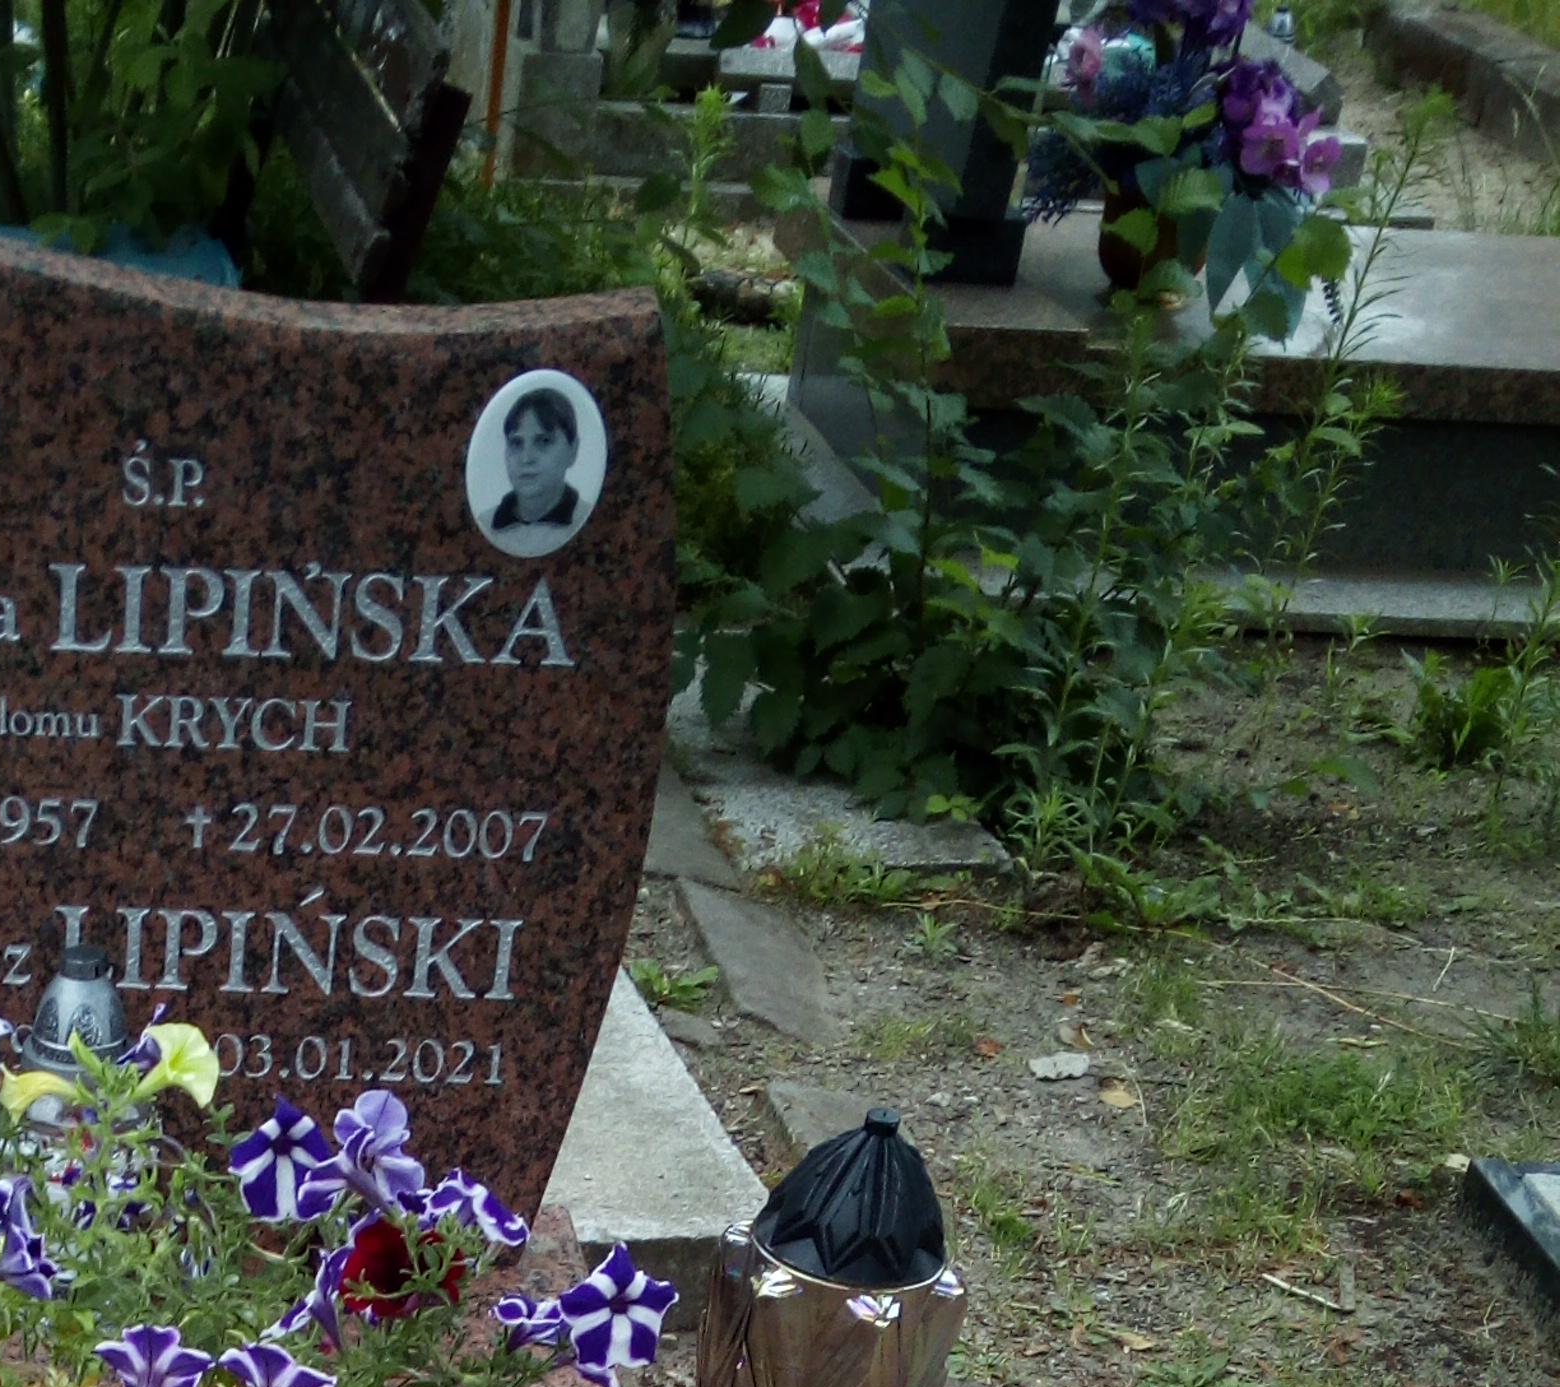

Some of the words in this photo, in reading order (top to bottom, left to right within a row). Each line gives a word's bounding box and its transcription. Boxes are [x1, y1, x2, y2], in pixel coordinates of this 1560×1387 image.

[122, 440, 204, 507] Ś.P.
[48, 560, 576, 668] LIPIŃSKA
[116, 693, 353, 753] KRYCH
[228, 802, 549, 863] 27.02.2007
[214, 1032, 505, 1086] 03.01.2021
